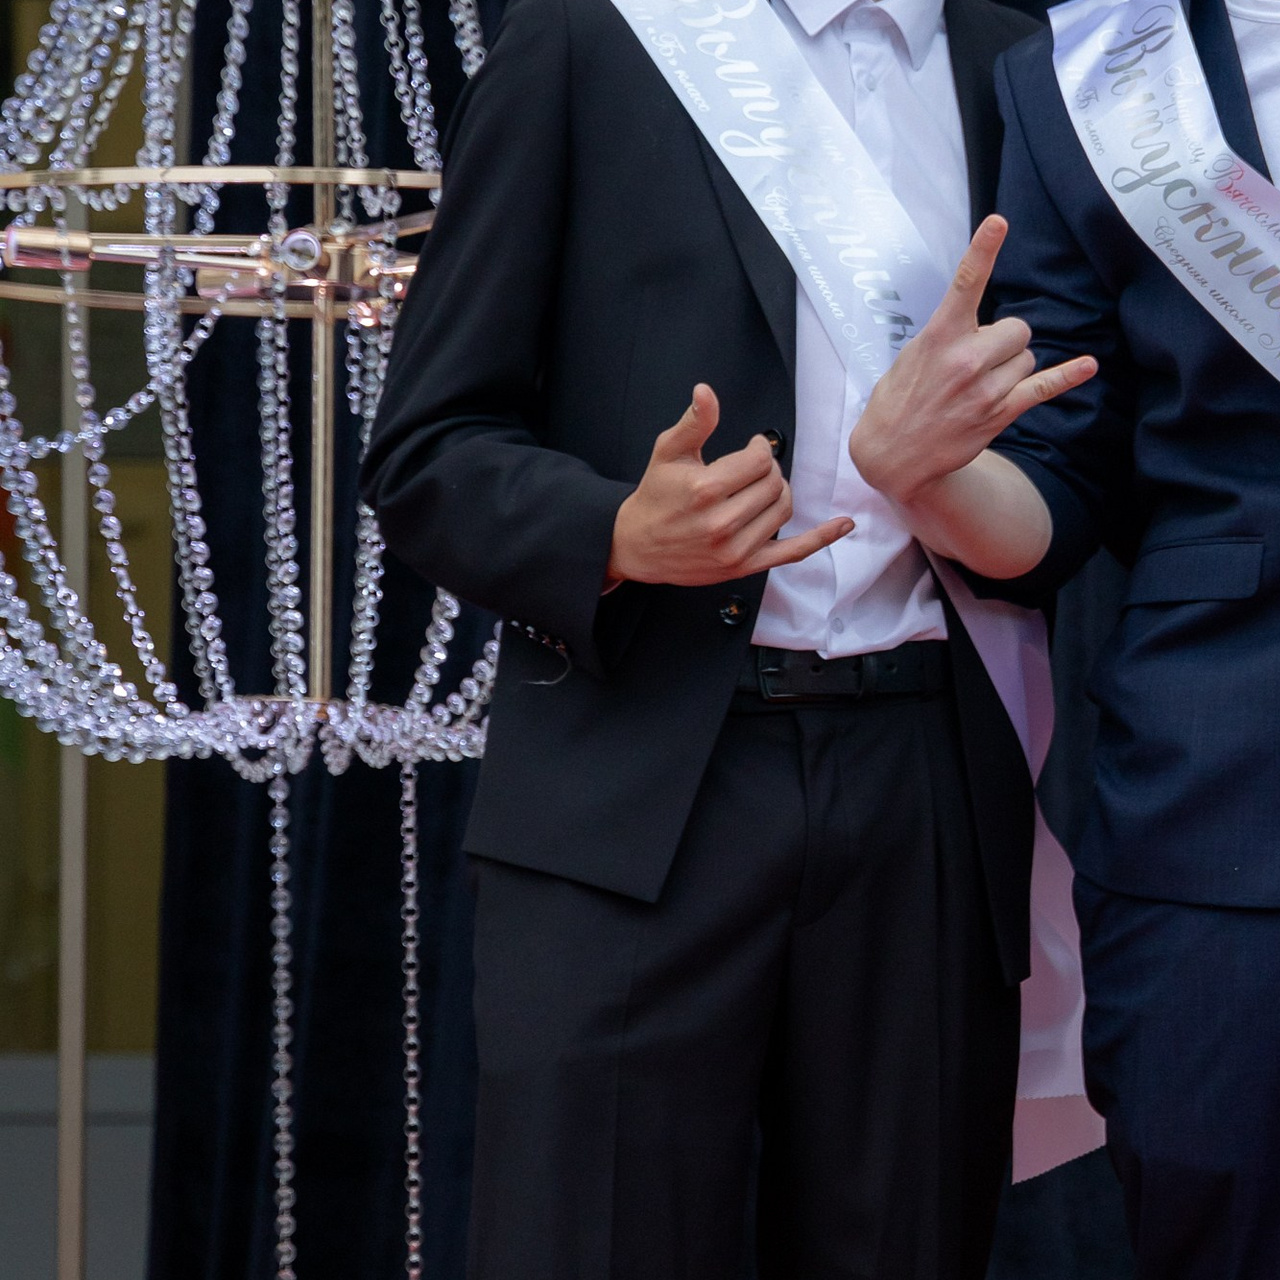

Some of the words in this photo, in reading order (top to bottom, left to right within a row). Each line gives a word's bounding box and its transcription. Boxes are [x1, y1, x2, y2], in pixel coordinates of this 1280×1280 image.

[674, 67, 711, 113] класс
[763, 185, 812, 263] Средняя
[808, 265, 846, 320] школа
[1153, 216, 1209, 288] Средняя
[1208, 287, 1255, 334] школа
